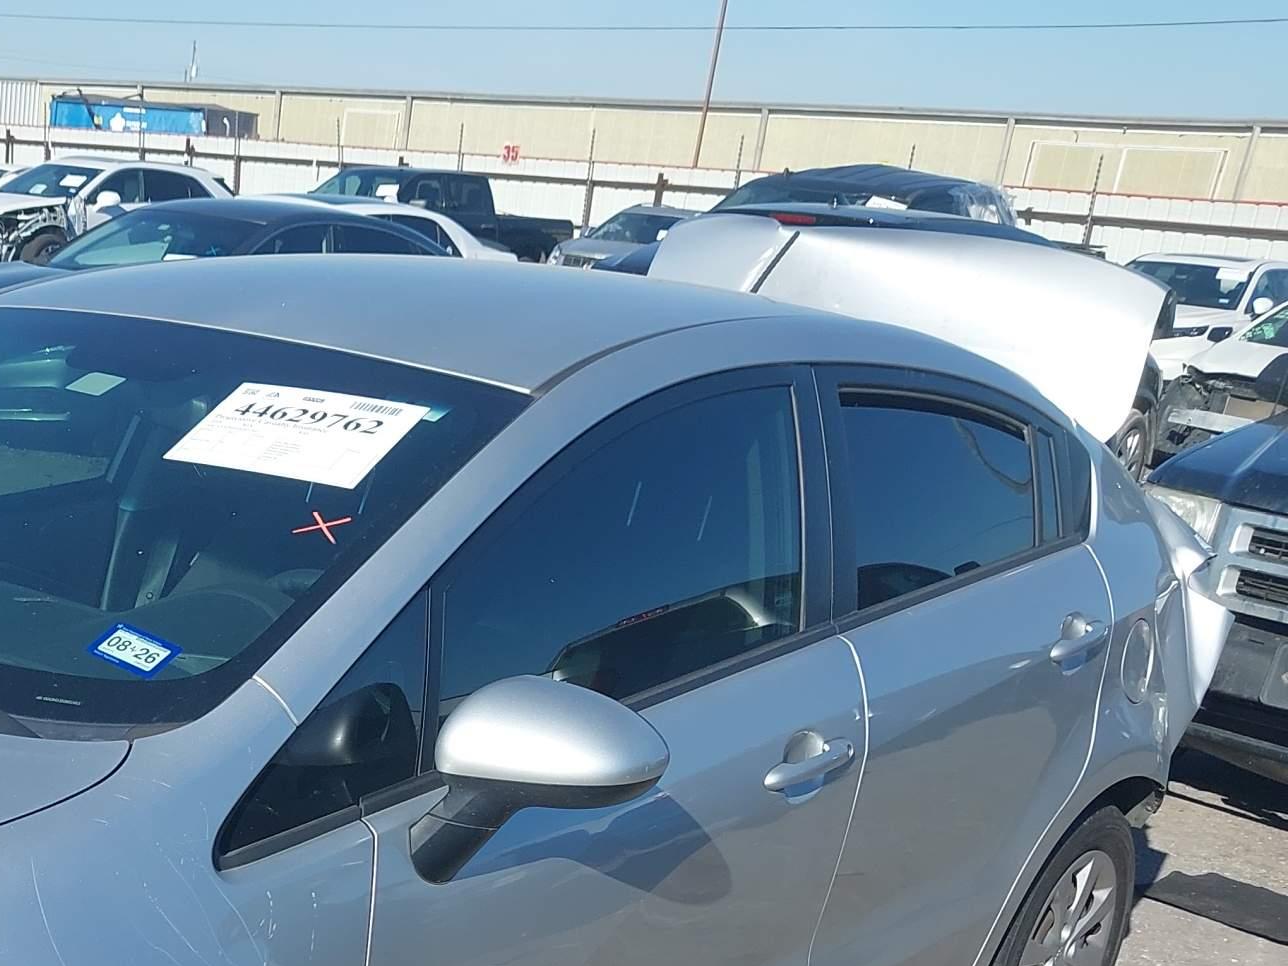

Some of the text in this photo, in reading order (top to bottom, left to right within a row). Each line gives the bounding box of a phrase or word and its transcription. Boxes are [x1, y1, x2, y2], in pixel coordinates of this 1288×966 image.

[503, 145, 520, 162] 35
[234, 402, 384, 435] 44629762
[107, 636, 132, 652] 08
[133, 648, 160, 664] 26
